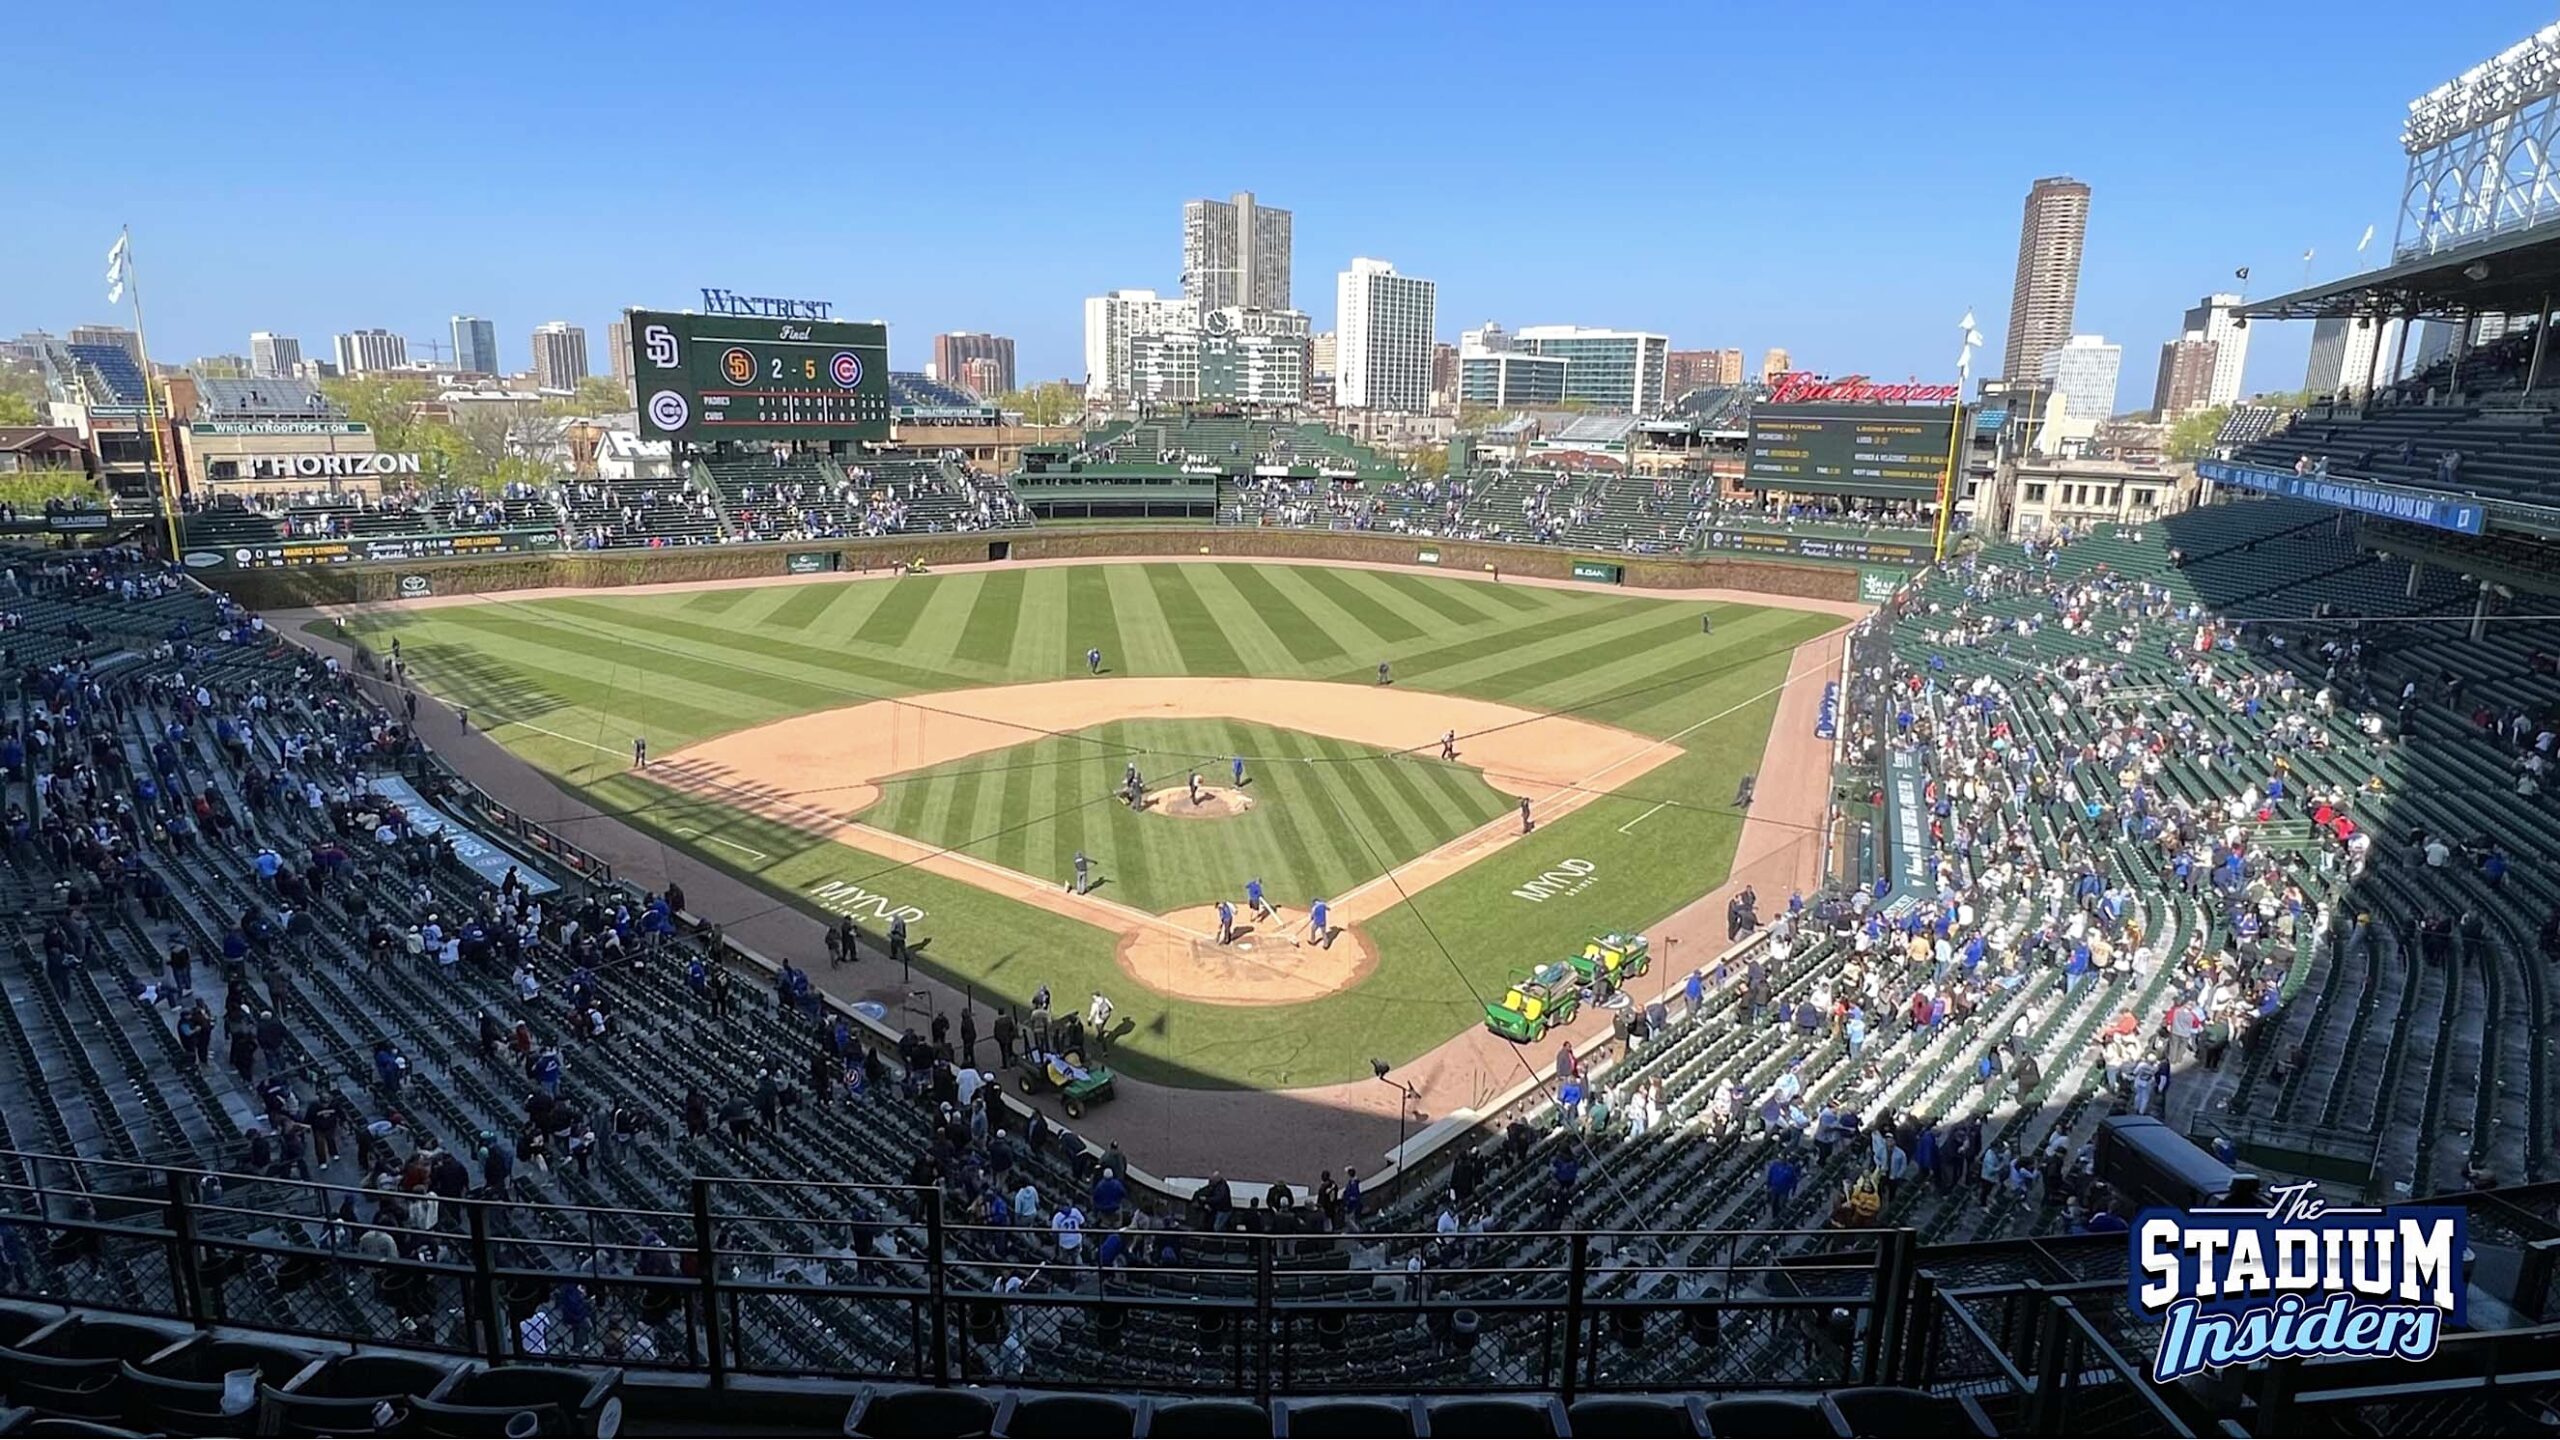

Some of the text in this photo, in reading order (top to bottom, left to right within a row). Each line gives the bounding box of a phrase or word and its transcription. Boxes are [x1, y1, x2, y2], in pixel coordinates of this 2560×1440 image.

[701, 288, 833, 320] WINTRUST
[779, 325, 813, 341] Final
[771, 358, 783, 379] 2
[805, 360, 817, 380] 5
[271, 453, 421, 476] HORIZON
[2319, 485, 2351, 505] CHICAGO,
[2353, 489, 2379, 510] WHAT
[2377, 493, 2393, 512] DO
[2394, 496, 2412, 517] YOU
[2414, 500, 2434, 520] SAY
[400, 589, 432, 598] TOYOTA
[1511, 859, 1595, 902] MYND
[810, 880, 925, 923] MYND
